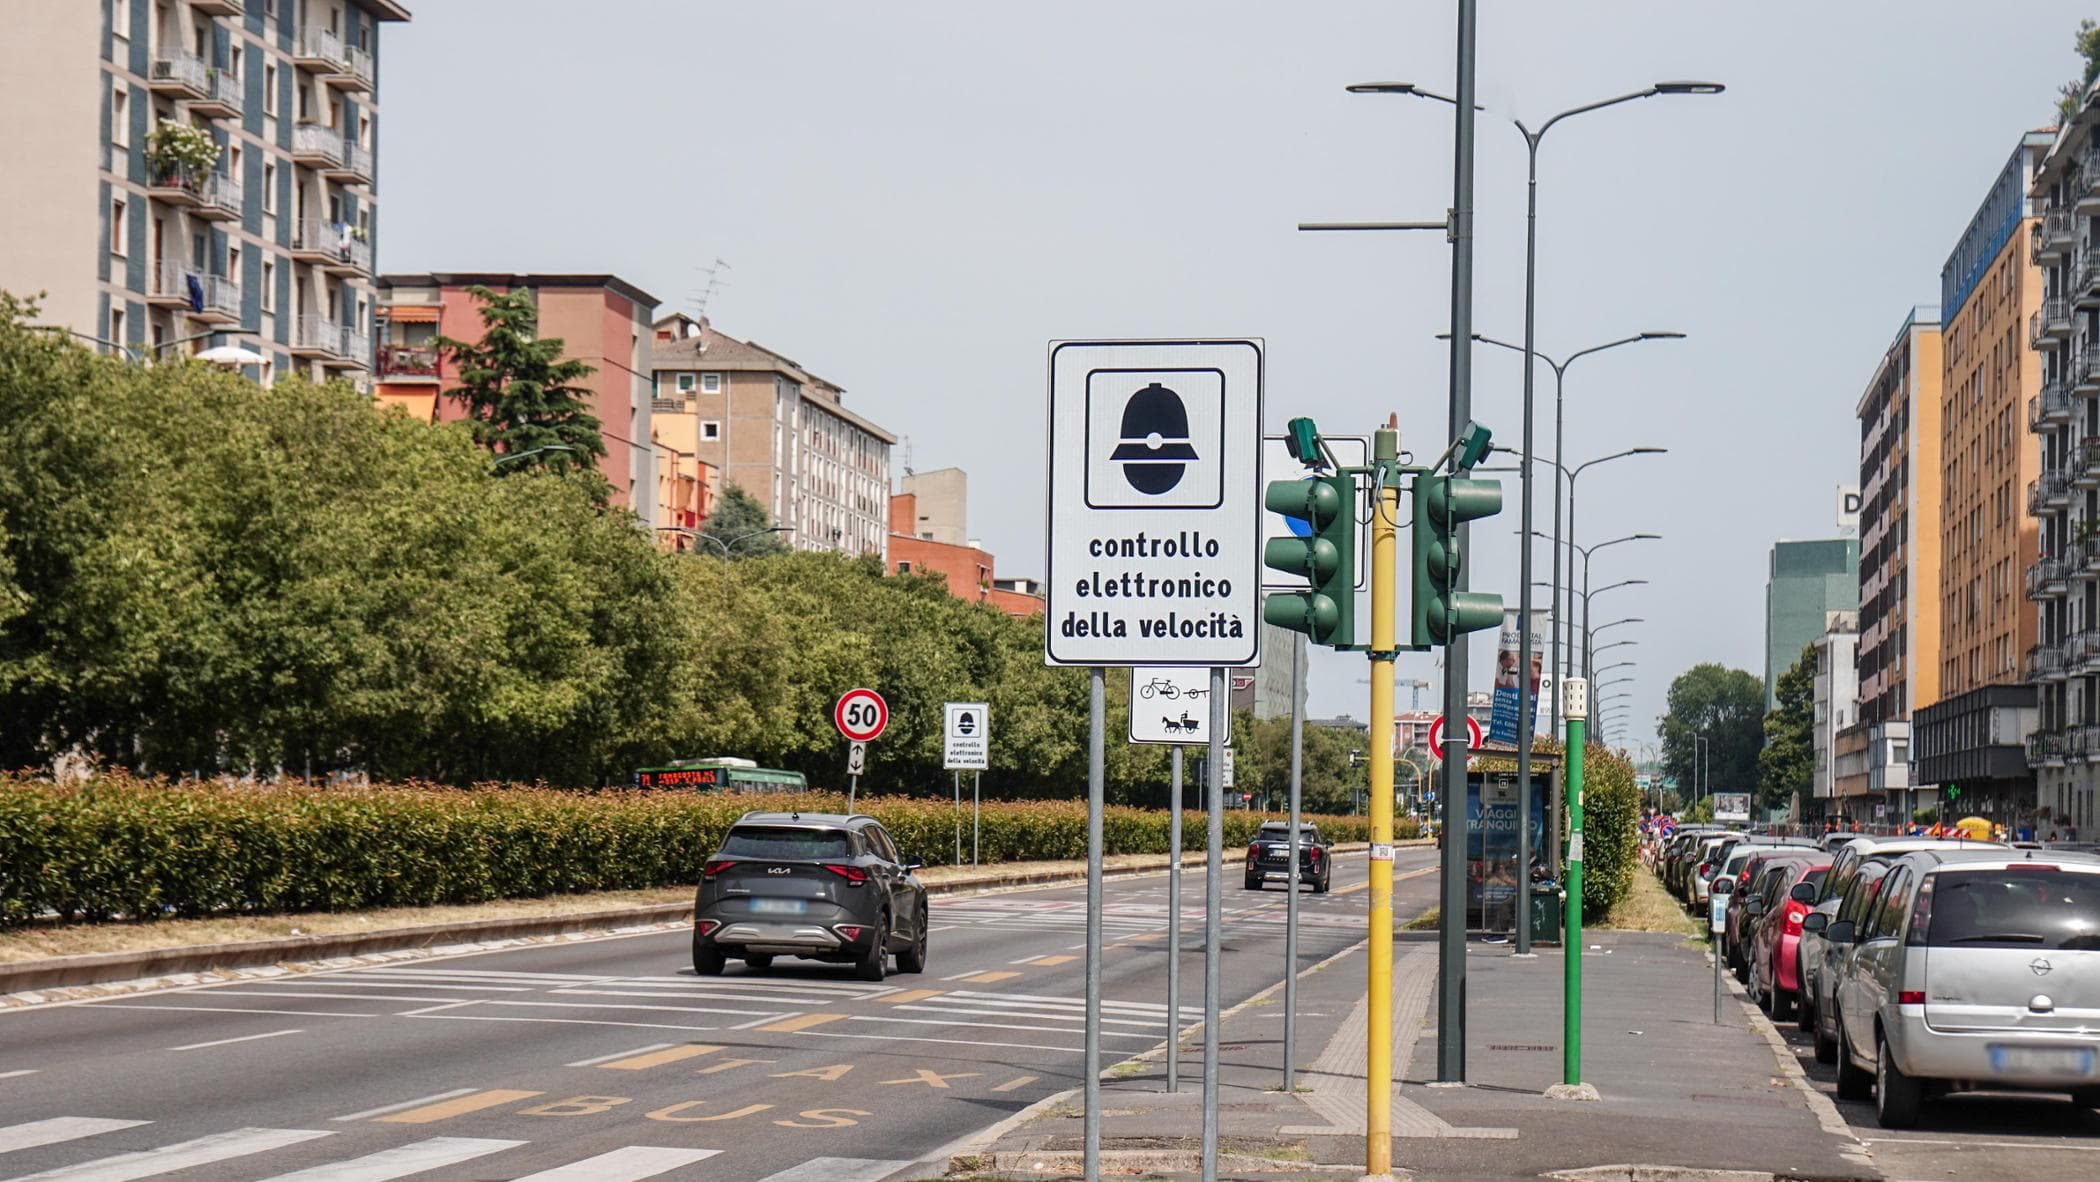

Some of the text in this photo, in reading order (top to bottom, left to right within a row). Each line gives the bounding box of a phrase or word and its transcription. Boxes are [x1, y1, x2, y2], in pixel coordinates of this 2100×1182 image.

[1089, 531, 1220, 558] controllo
[1075, 571, 1232, 598] elettronico
[1061, 611, 1244, 638] della velocità
[847, 703, 877, 727] 50
[697, 1057, 1041, 1093] TAXI
[515, 1094, 874, 1129] BUS
